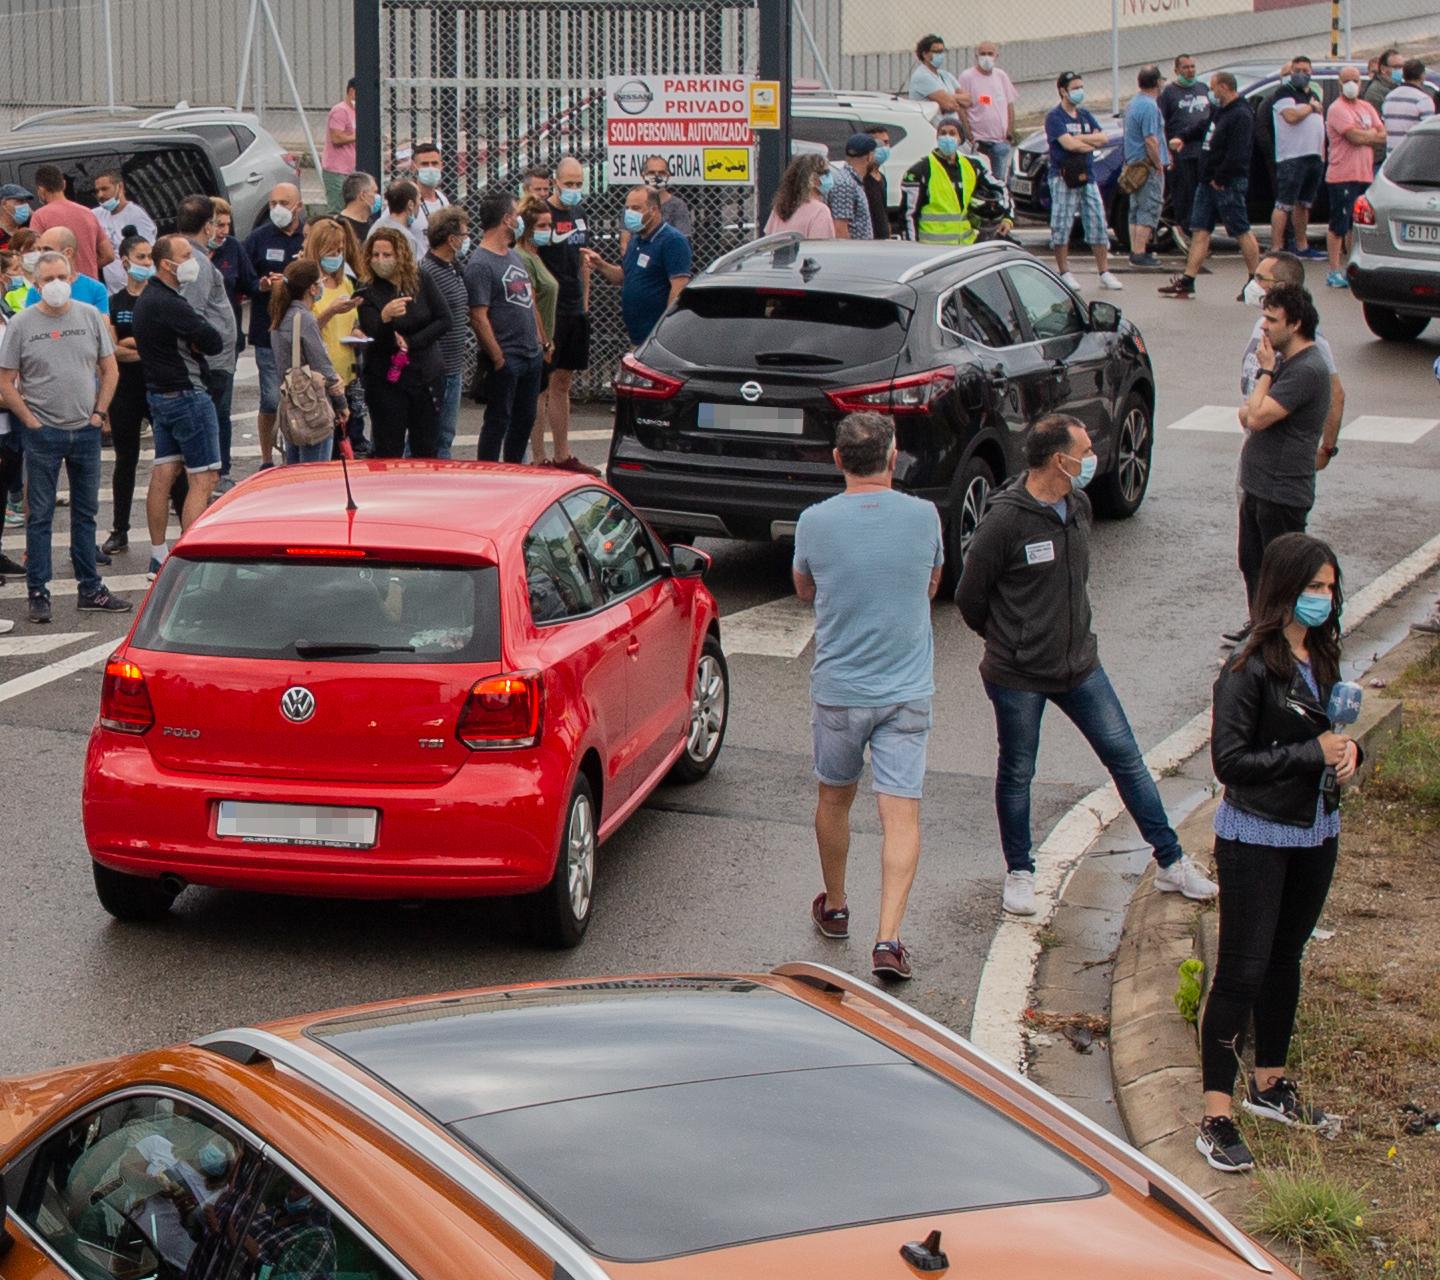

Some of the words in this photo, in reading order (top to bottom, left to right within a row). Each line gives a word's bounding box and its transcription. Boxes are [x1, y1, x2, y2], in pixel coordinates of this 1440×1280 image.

[664, 79, 745, 93] PARKING
[616, 93, 652, 102] NISSAN
[665, 100, 745, 113] PRIVADO
[611, 123, 636, 142] SOLO
[639, 122, 687, 142] PERSONAL
[688, 122, 750, 142] AUTORIZADO
[613, 154, 626, 177] SE
[669, 154, 701, 176] GRUA
[1408, 225, 1438, 240] 6110
[162, 726, 201, 738] POLO
